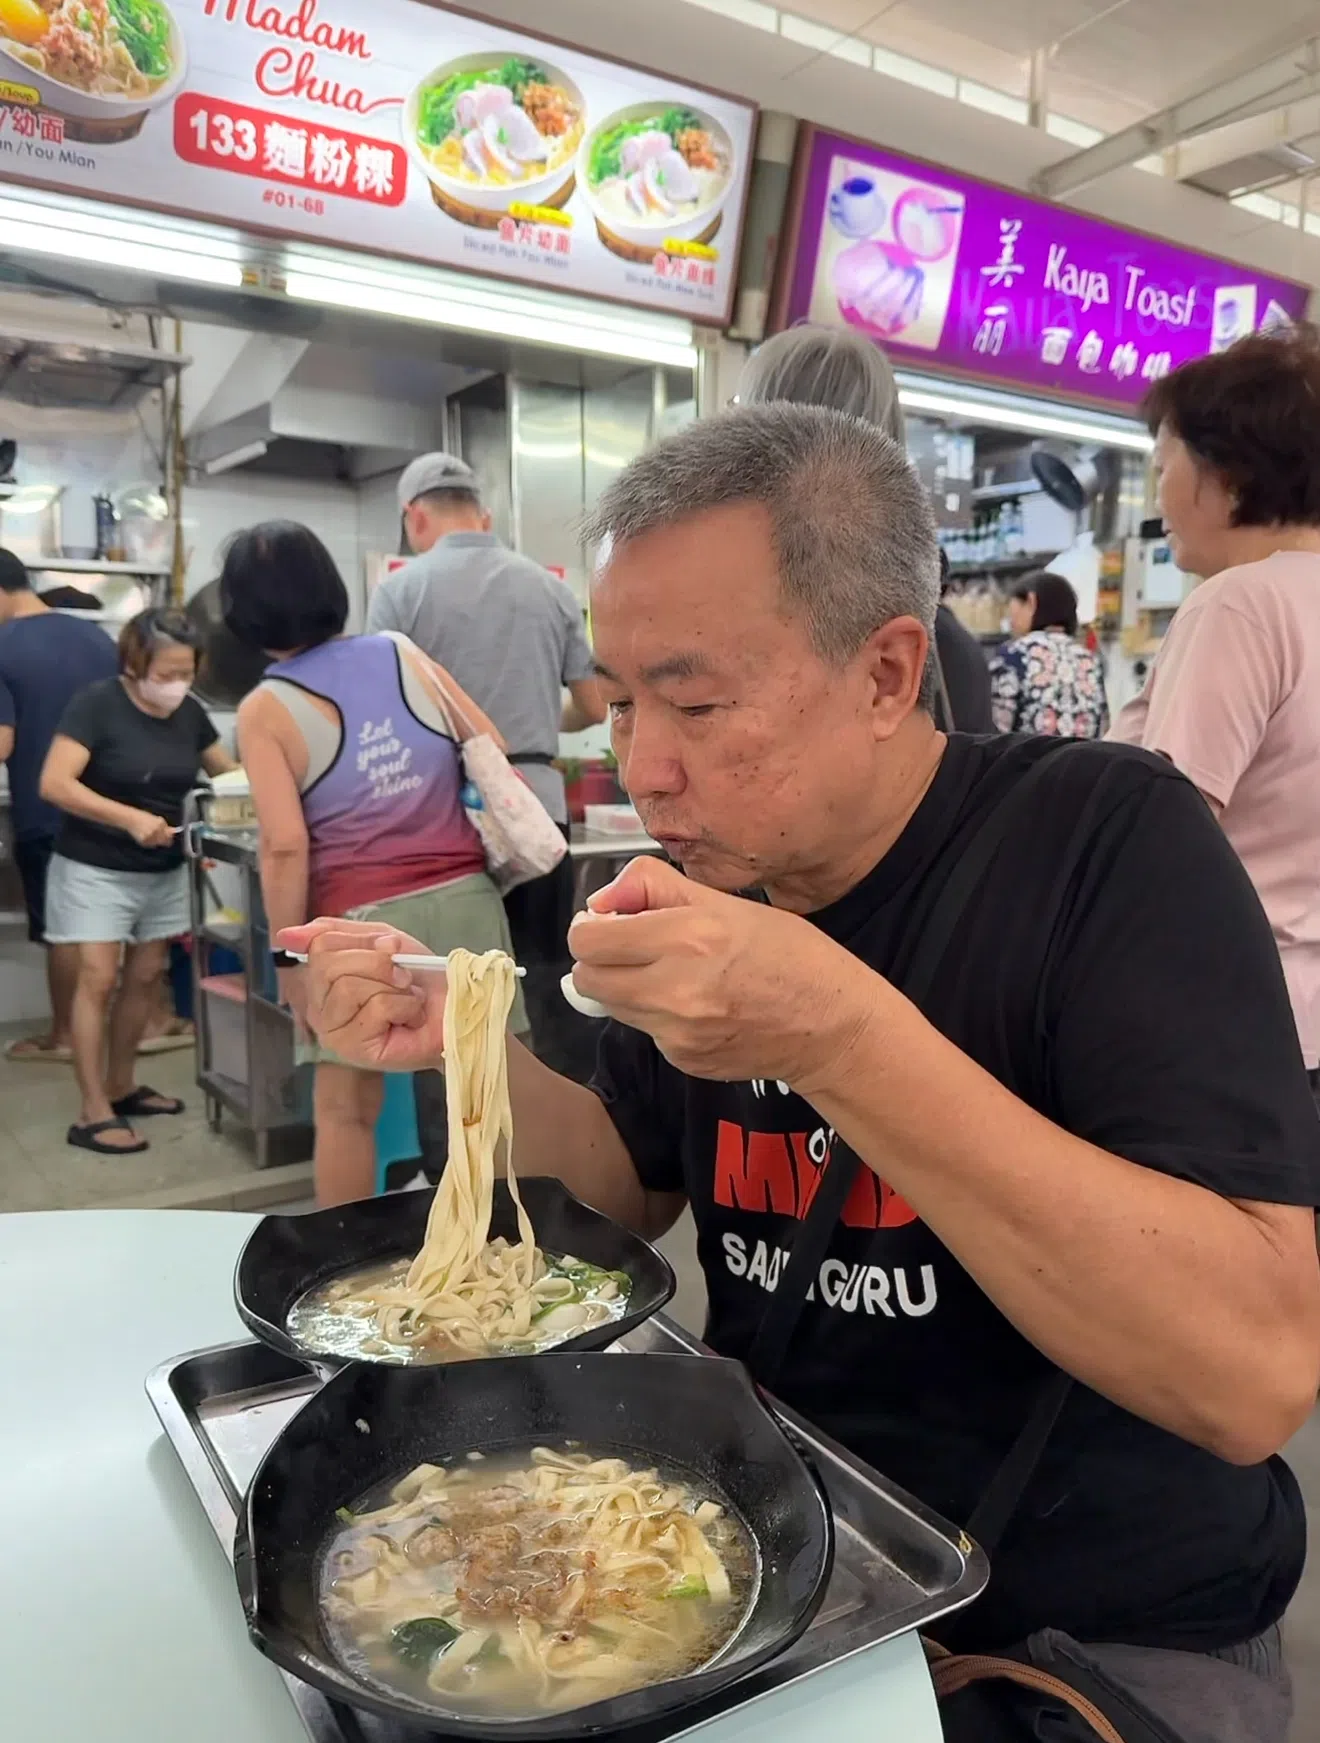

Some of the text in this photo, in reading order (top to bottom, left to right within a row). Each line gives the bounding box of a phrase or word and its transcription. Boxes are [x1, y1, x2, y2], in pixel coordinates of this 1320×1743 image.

[255, 47, 404, 113] Chua
[58, 149, 96, 169] Mian
[1043, 242, 1197, 327] Kaya Toast
[358, 717, 393, 746] Let
[356, 736, 401, 772] your
[368, 747, 412, 781] soul
[721, 1232, 938, 1318] SADGURU
